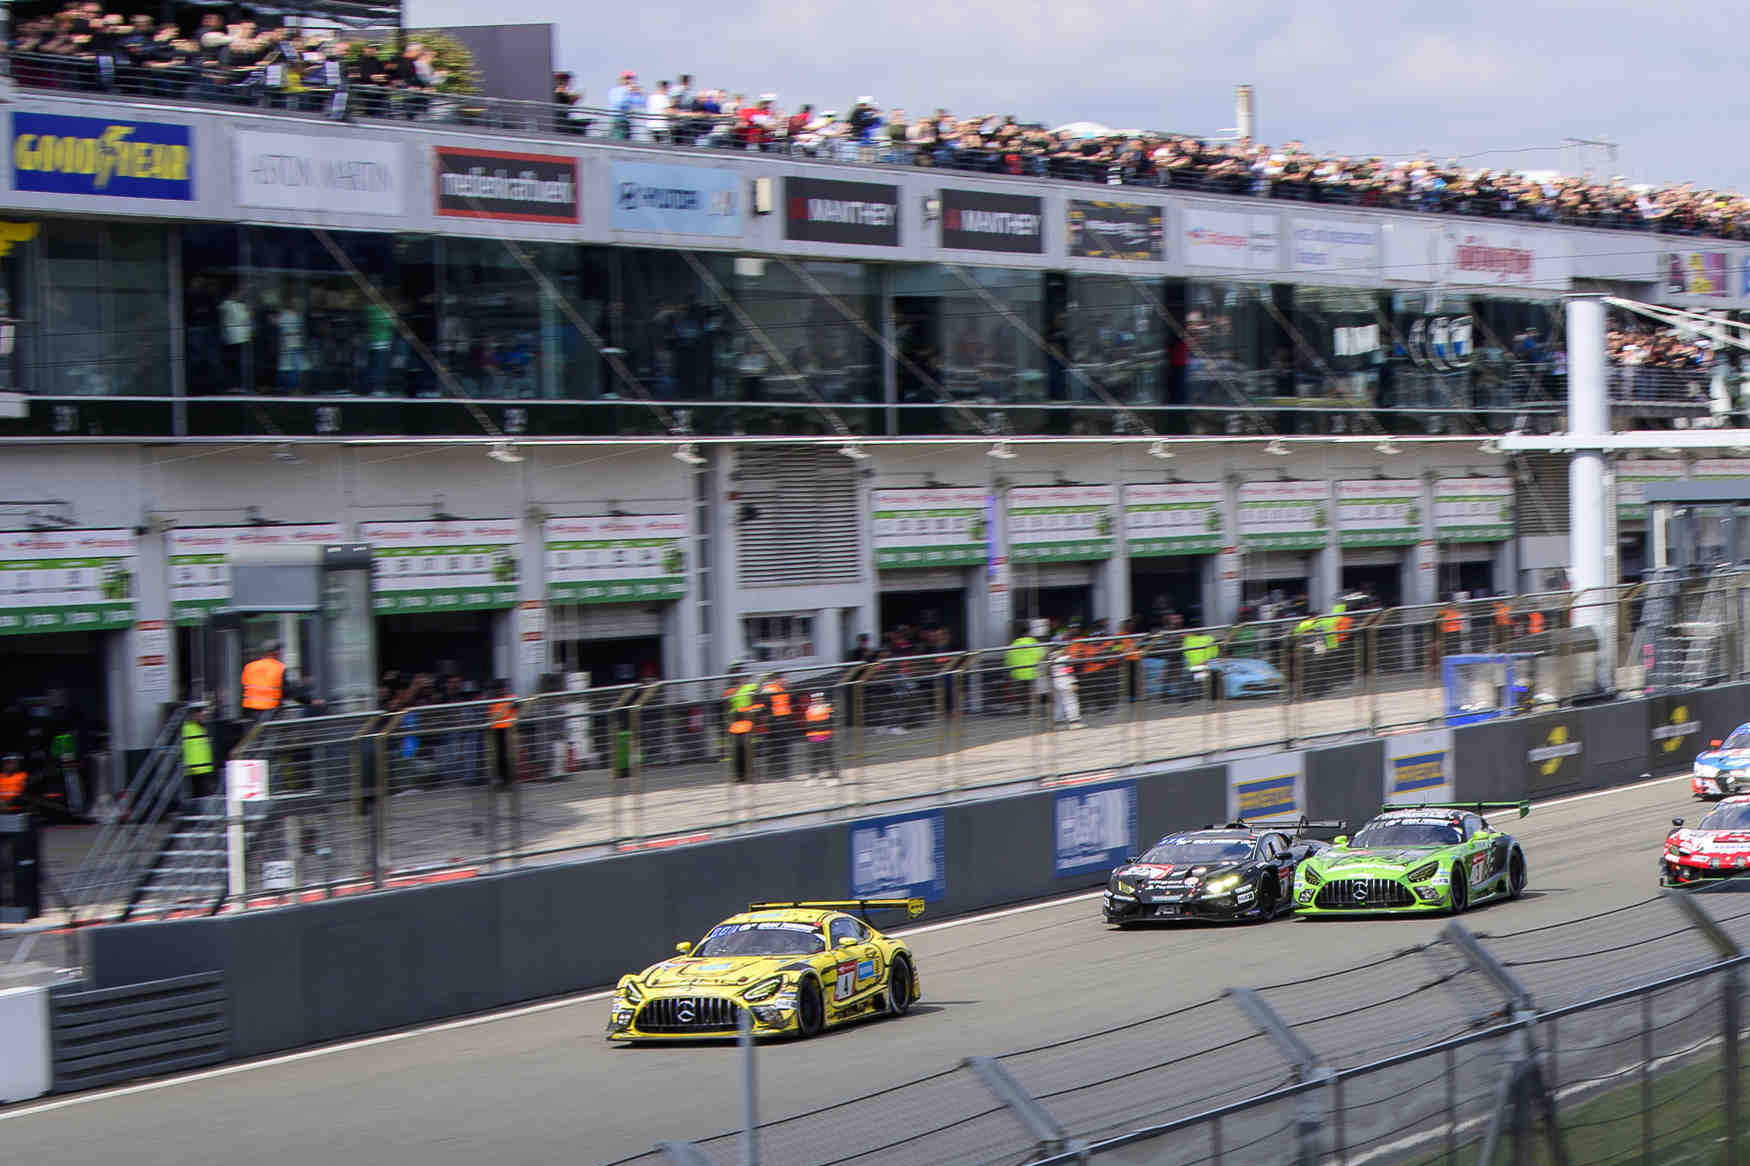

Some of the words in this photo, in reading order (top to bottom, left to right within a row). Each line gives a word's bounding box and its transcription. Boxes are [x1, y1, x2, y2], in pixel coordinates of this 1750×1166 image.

[14, 126, 190, 188] GOODYEAR
[807, 198, 897, 226] MANTHEY
[959, 210, 1040, 236] MANTHEY
